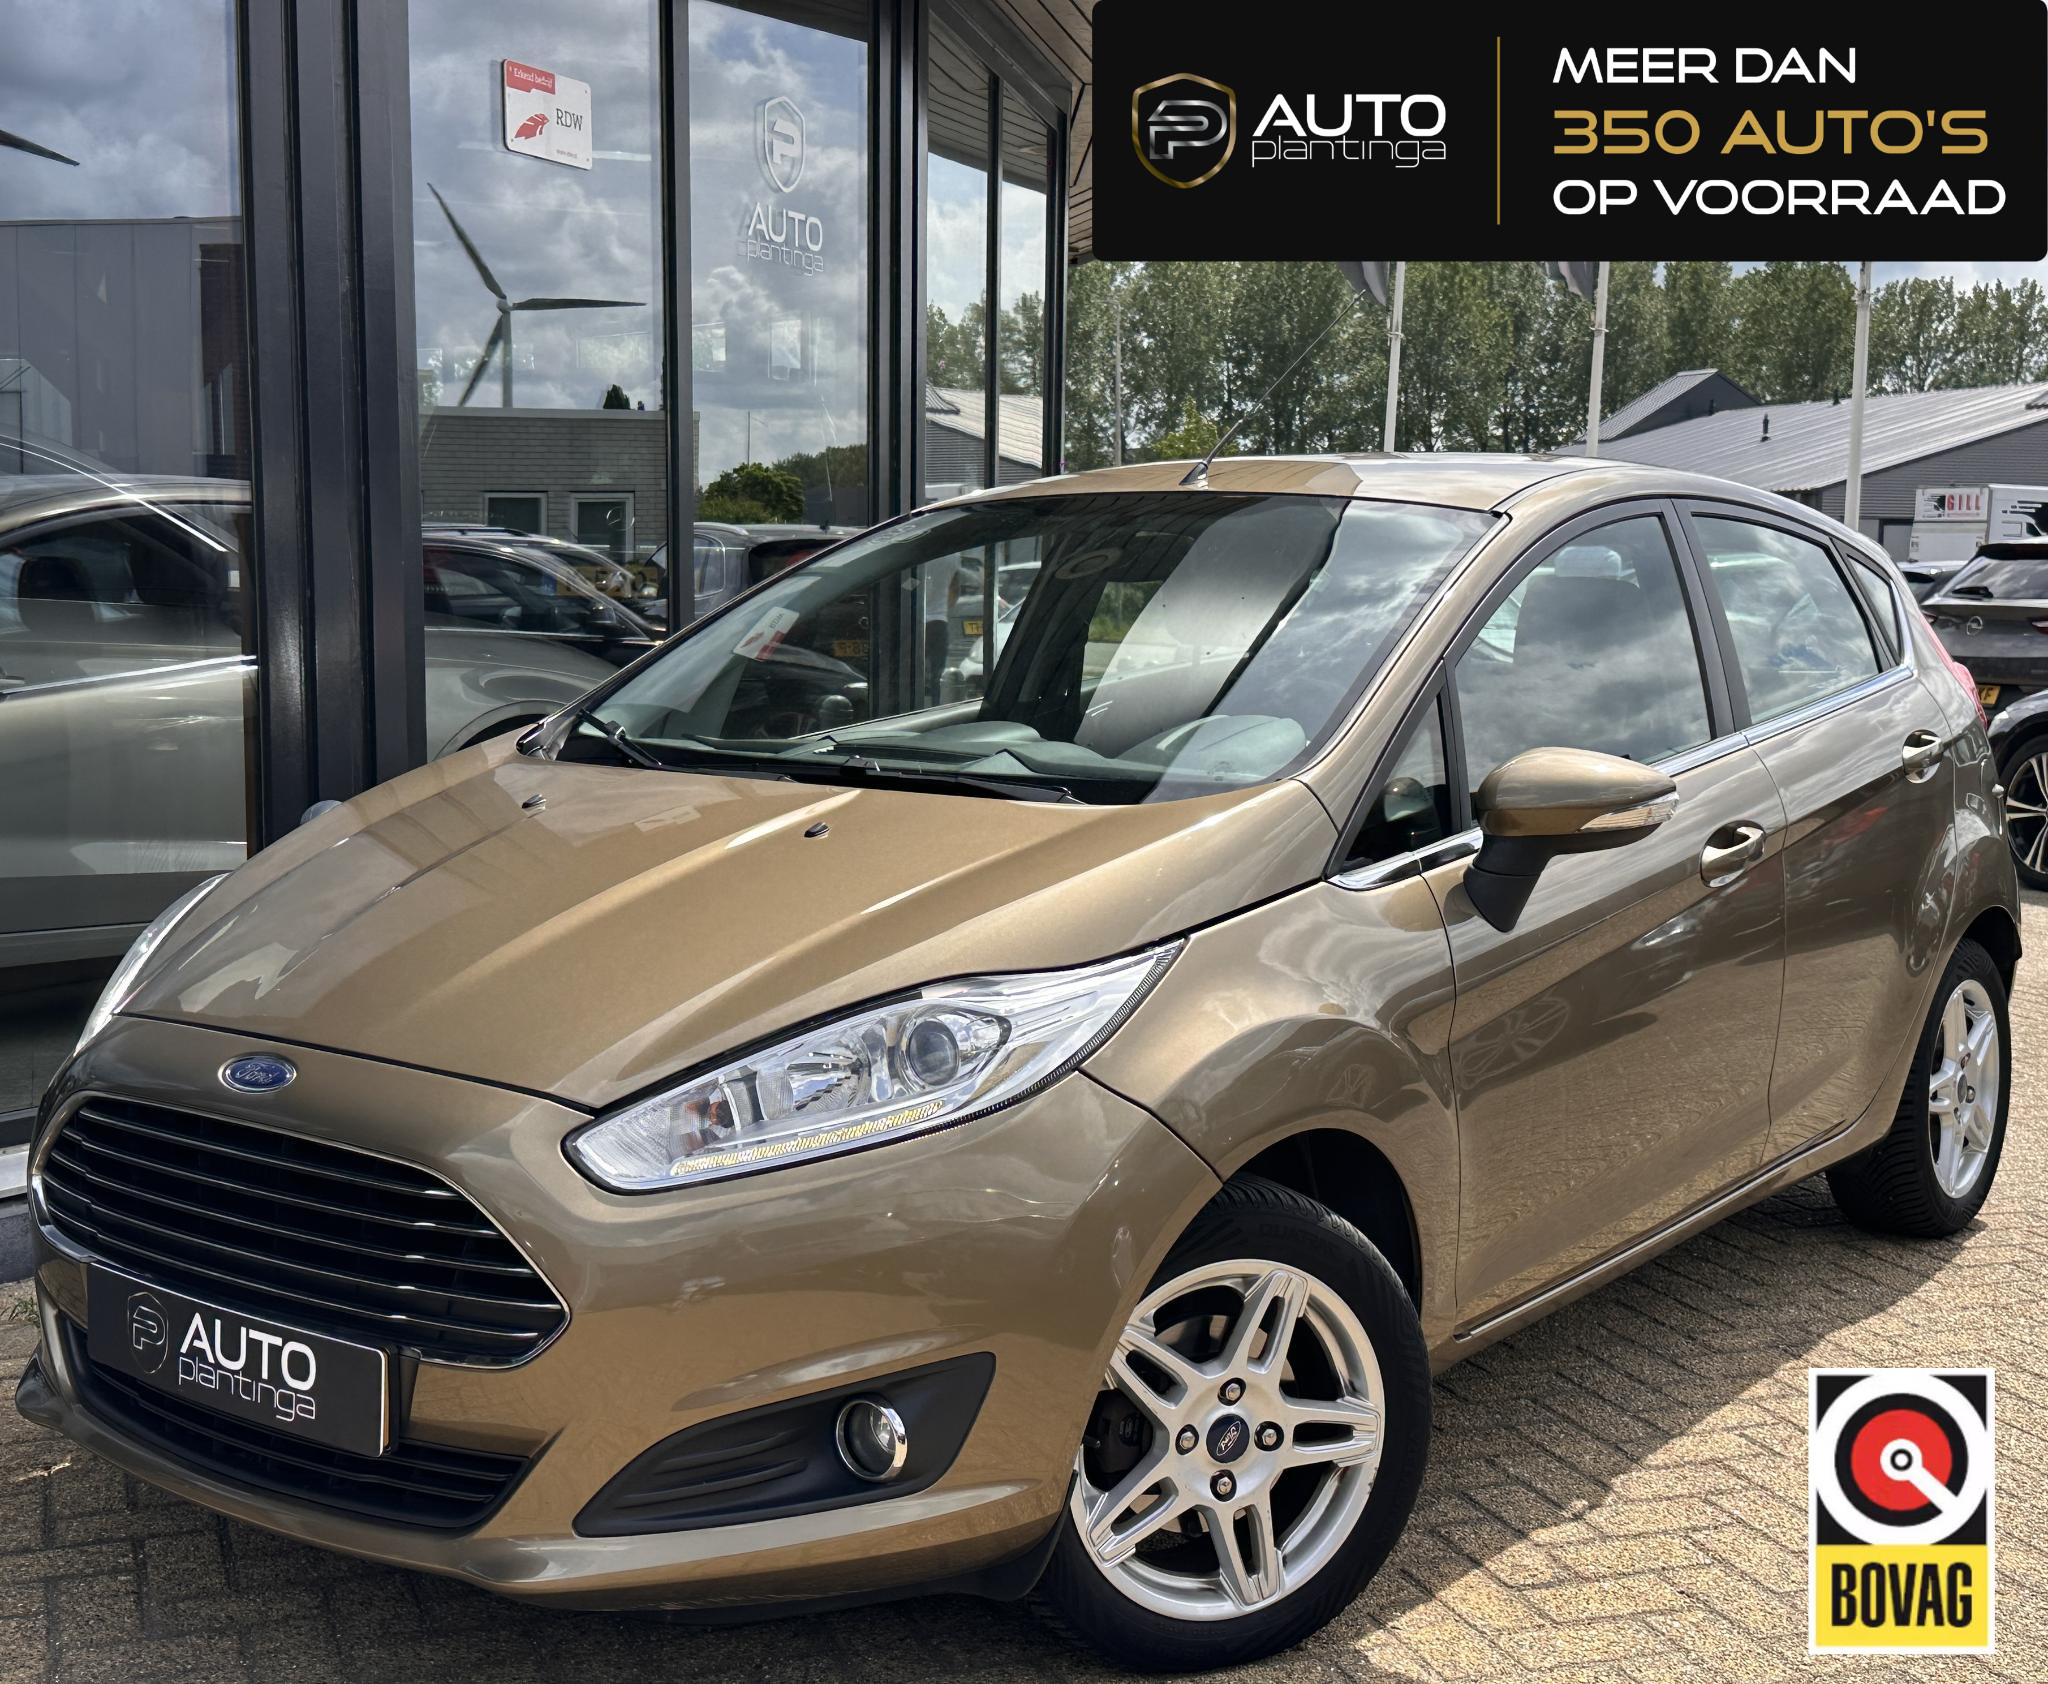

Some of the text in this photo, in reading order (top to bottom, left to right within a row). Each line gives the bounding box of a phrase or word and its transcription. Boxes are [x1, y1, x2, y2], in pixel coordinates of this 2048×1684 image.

[556, 107, 583, 132] RDW
[748, 202, 823, 252] AUTO
[747, 238, 824, 277] plantinga
[1946, 494, 1981, 512] GILL
[235, 1062, 280, 1084] Ford
[180, 1312, 317, 1390] AUTO
[178, 1356, 317, 1422] plantinga
